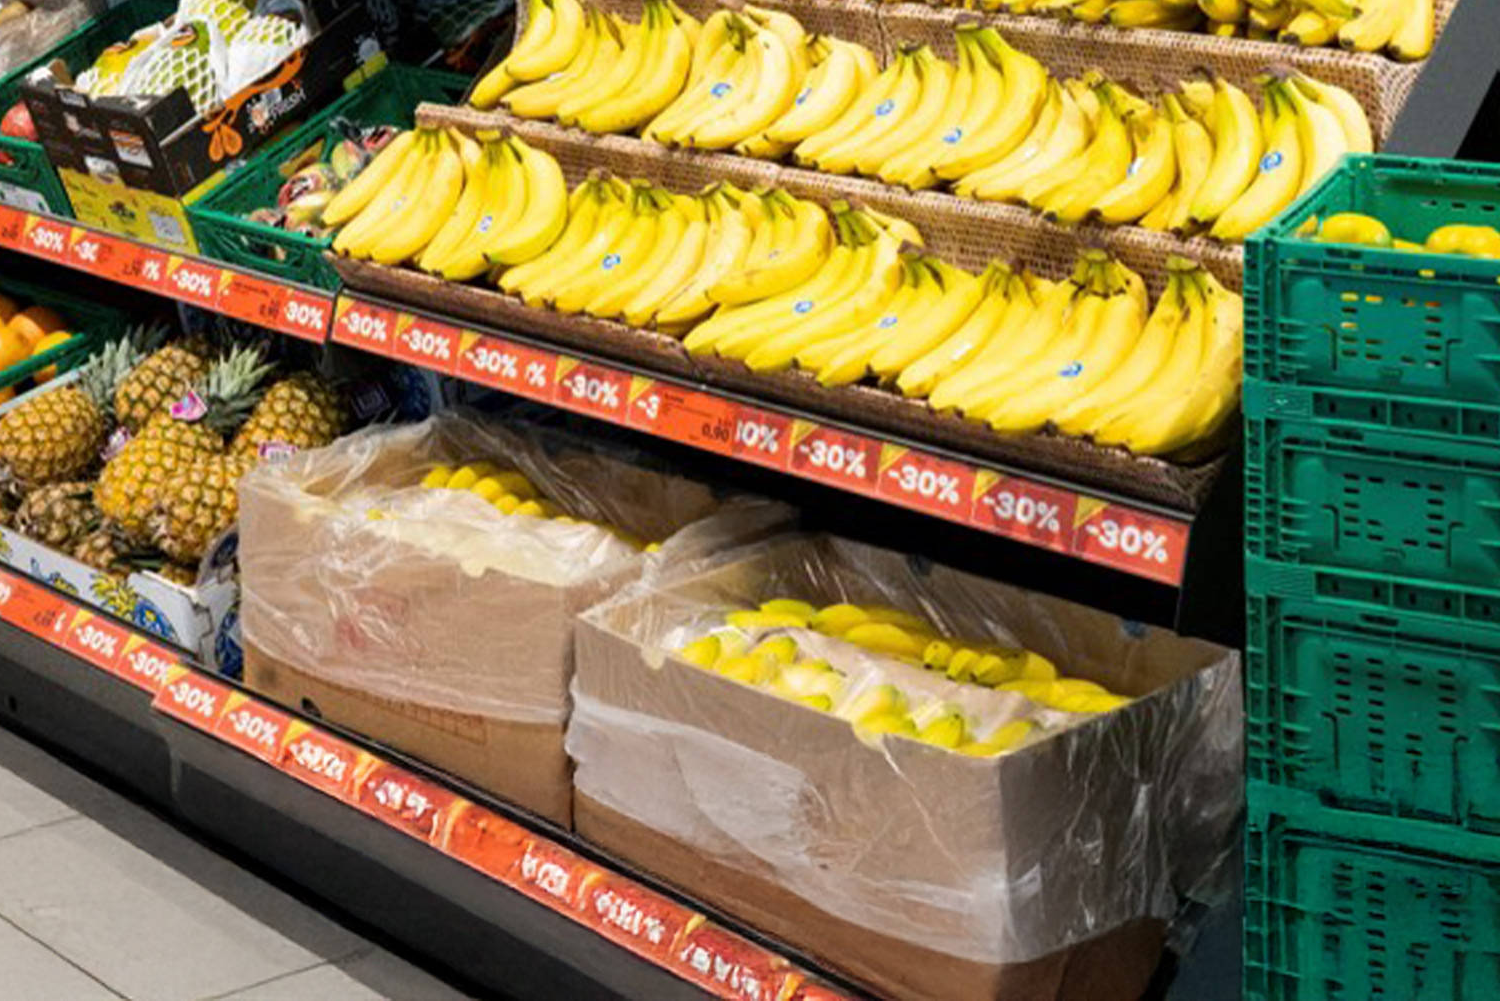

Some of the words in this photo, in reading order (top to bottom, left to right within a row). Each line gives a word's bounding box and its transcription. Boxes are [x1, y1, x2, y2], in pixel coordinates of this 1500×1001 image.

[32, 227, 64, 252] -30%
[172, 269, 212, 296] -30%
[341, 311, 387, 341] -30%
[401, 328, 450, 359] -30%
[466, 347, 518, 378] -30%
[562, 373, 619, 407] -30%
[800, 439, 866, 478] -30%
[888, 464, 960, 505] -30%
[983, 492, 1060, 532] -30%
[1085, 519, 1168, 563] -30%
[75, 623, 118, 658] -30%
[128, 650, 172, 685] -30%
[168, 682, 216, 720] -30%
[228, 711, 278, 747] -30%
